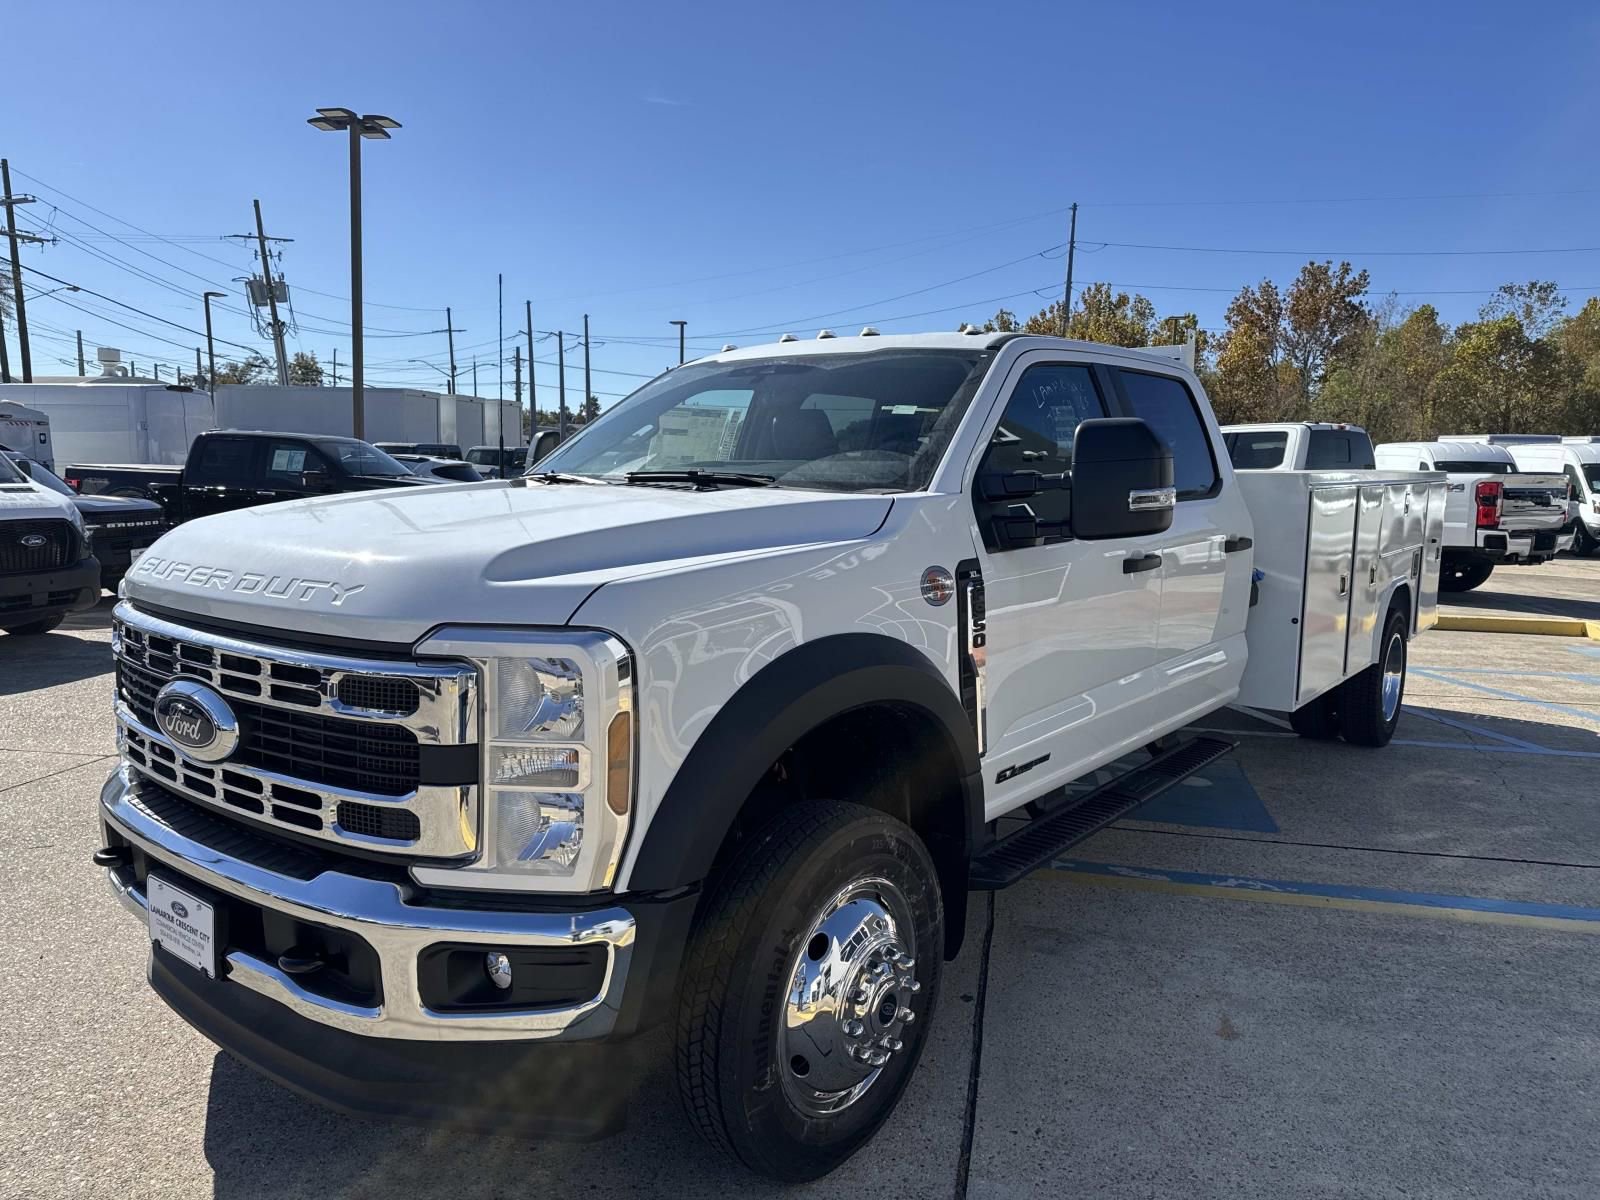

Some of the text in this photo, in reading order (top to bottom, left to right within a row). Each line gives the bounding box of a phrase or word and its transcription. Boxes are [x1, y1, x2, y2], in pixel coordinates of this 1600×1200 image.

[106, 520, 159, 529] BRONCO
[136, 556, 367, 606] SUPER DUTY
[165, 702, 202, 740] Ford
[175, 918, 199, 937] CRESCENT
[199, 931, 210, 944] CITY
